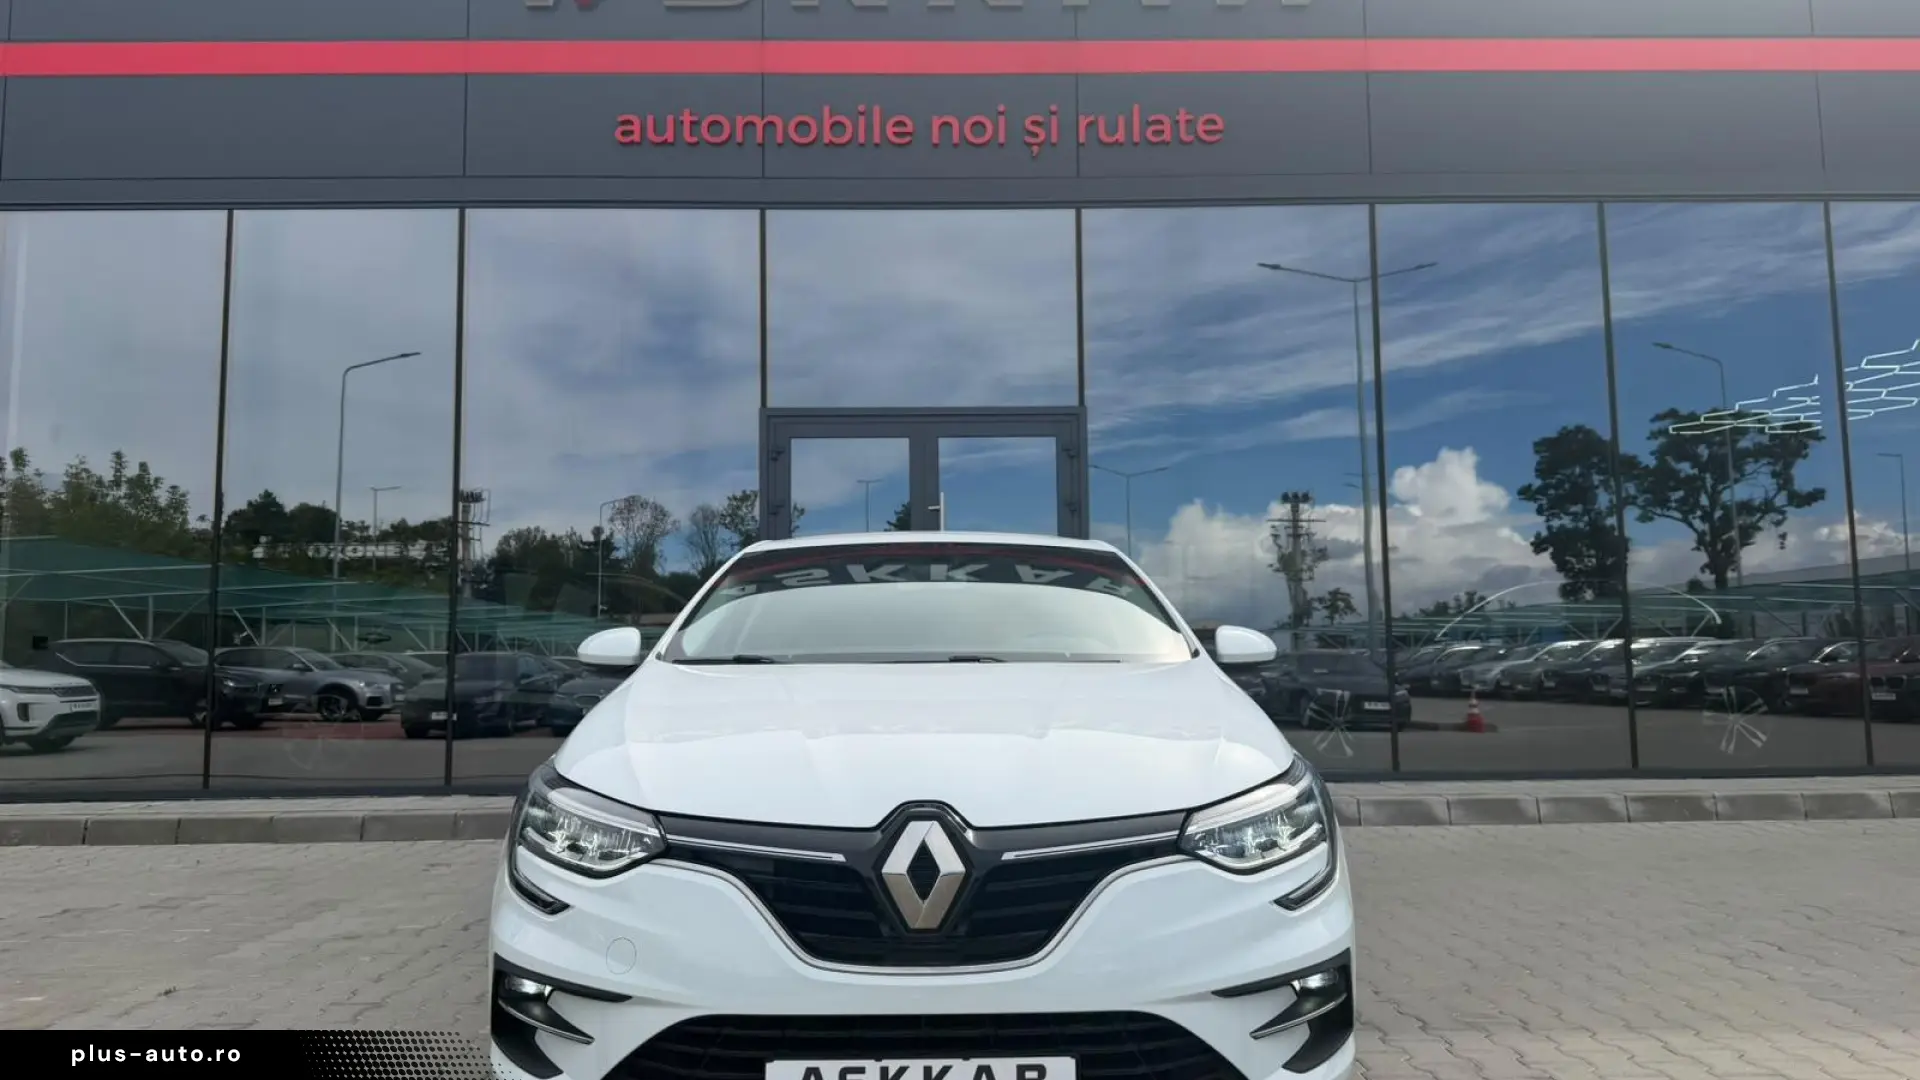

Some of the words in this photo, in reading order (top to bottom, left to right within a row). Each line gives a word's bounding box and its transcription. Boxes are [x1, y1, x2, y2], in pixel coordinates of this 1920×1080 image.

[614, 105, 914, 145] automobile
[931, 104, 1006, 145] noi
[1023, 104, 1058, 157] și
[1078, 104, 1225, 145] rulate
